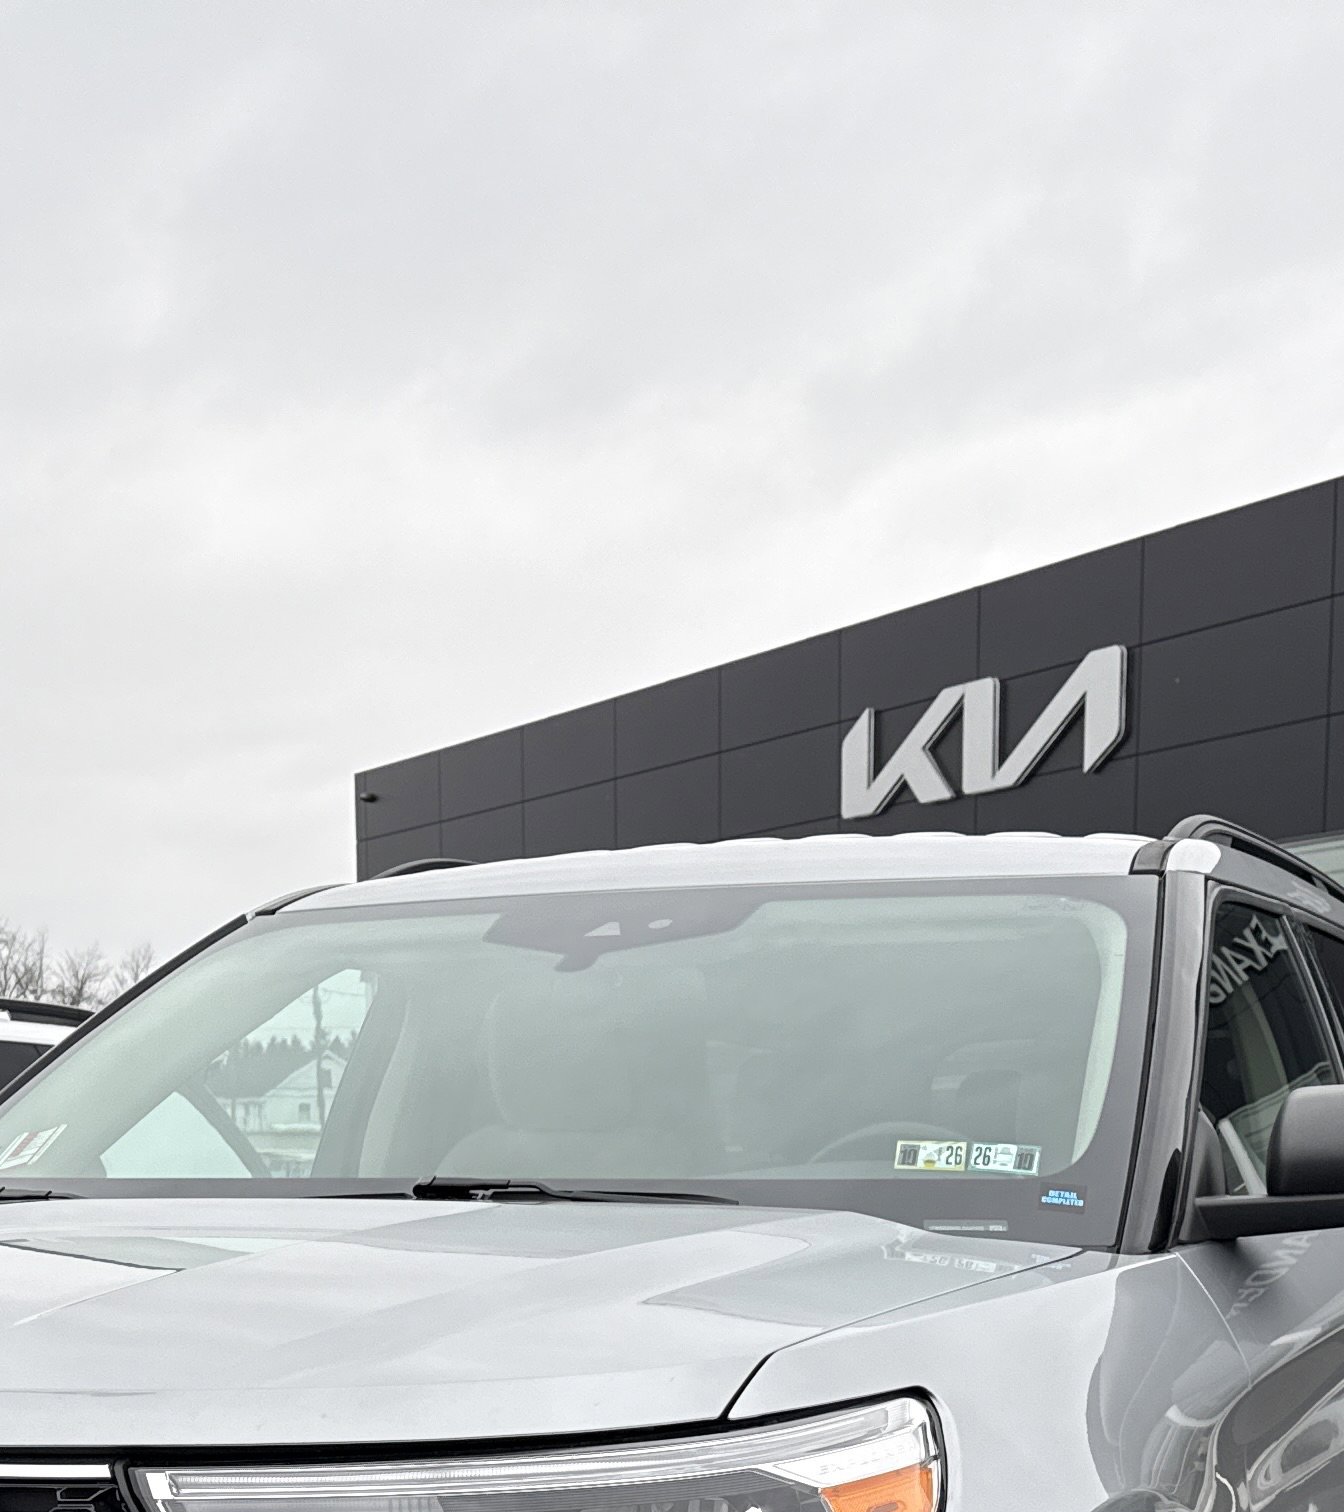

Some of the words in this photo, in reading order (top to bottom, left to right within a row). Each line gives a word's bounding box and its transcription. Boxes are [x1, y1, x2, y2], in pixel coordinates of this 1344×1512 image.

[841, 644, 1128, 820] KIA
[945, 1145, 963, 1166] 26
[973, 1146, 992, 1166] 26
